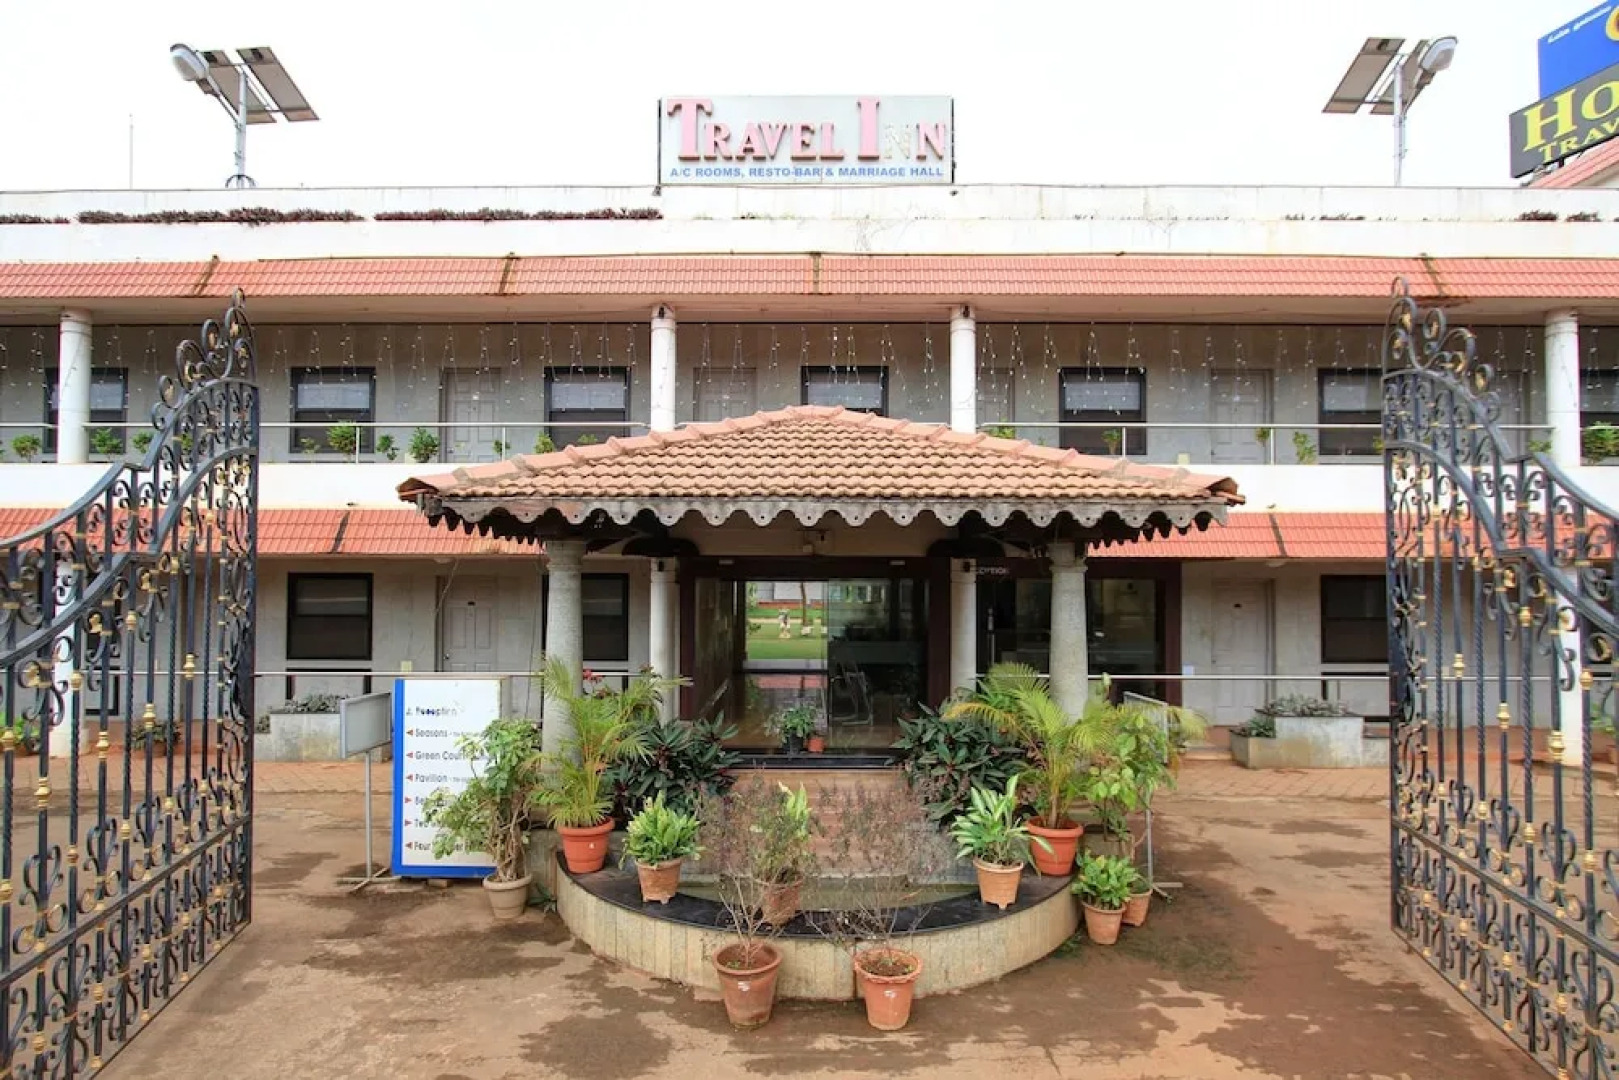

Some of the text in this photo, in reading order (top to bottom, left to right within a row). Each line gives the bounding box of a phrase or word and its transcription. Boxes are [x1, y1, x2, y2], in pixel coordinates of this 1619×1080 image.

[667, 97, 945, 161] TRAVEL INN
[670, 167, 944, 178] A/C ROOMS, RESTO-BAR & MARRIAGE HALL
[415, 728, 447, 738] Seasons
[415, 751, 440, 760] Green
[415, 773, 447, 783] Pavilion
